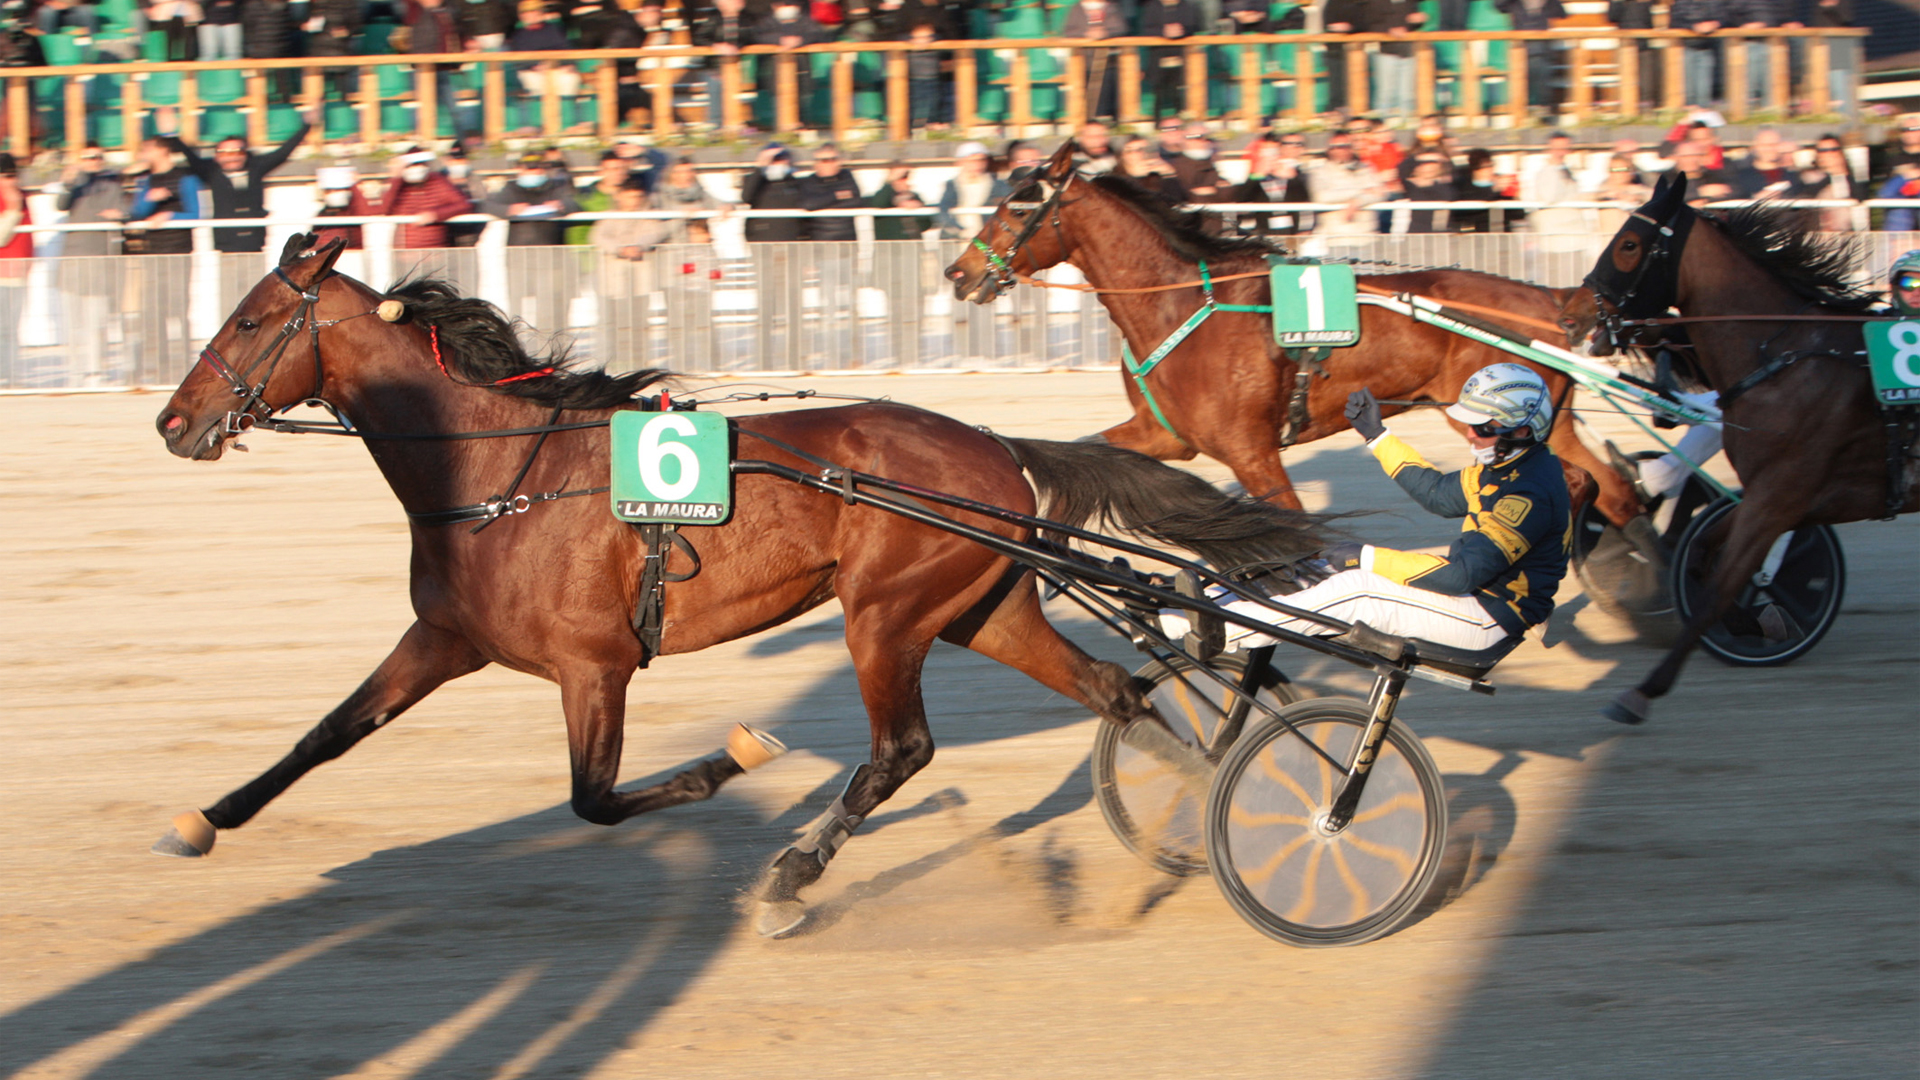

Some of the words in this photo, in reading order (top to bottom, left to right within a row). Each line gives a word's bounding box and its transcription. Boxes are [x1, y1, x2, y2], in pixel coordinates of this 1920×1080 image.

[1298, 266, 1325, 331] 1
[1284, 332, 1303, 343] LA
[1887, 321, 1920, 387] 8
[1886, 389, 1906, 400] LA
[638, 413, 700, 501] 6
[624, 503, 647, 517] LA
[653, 504, 718, 519] MAURA
